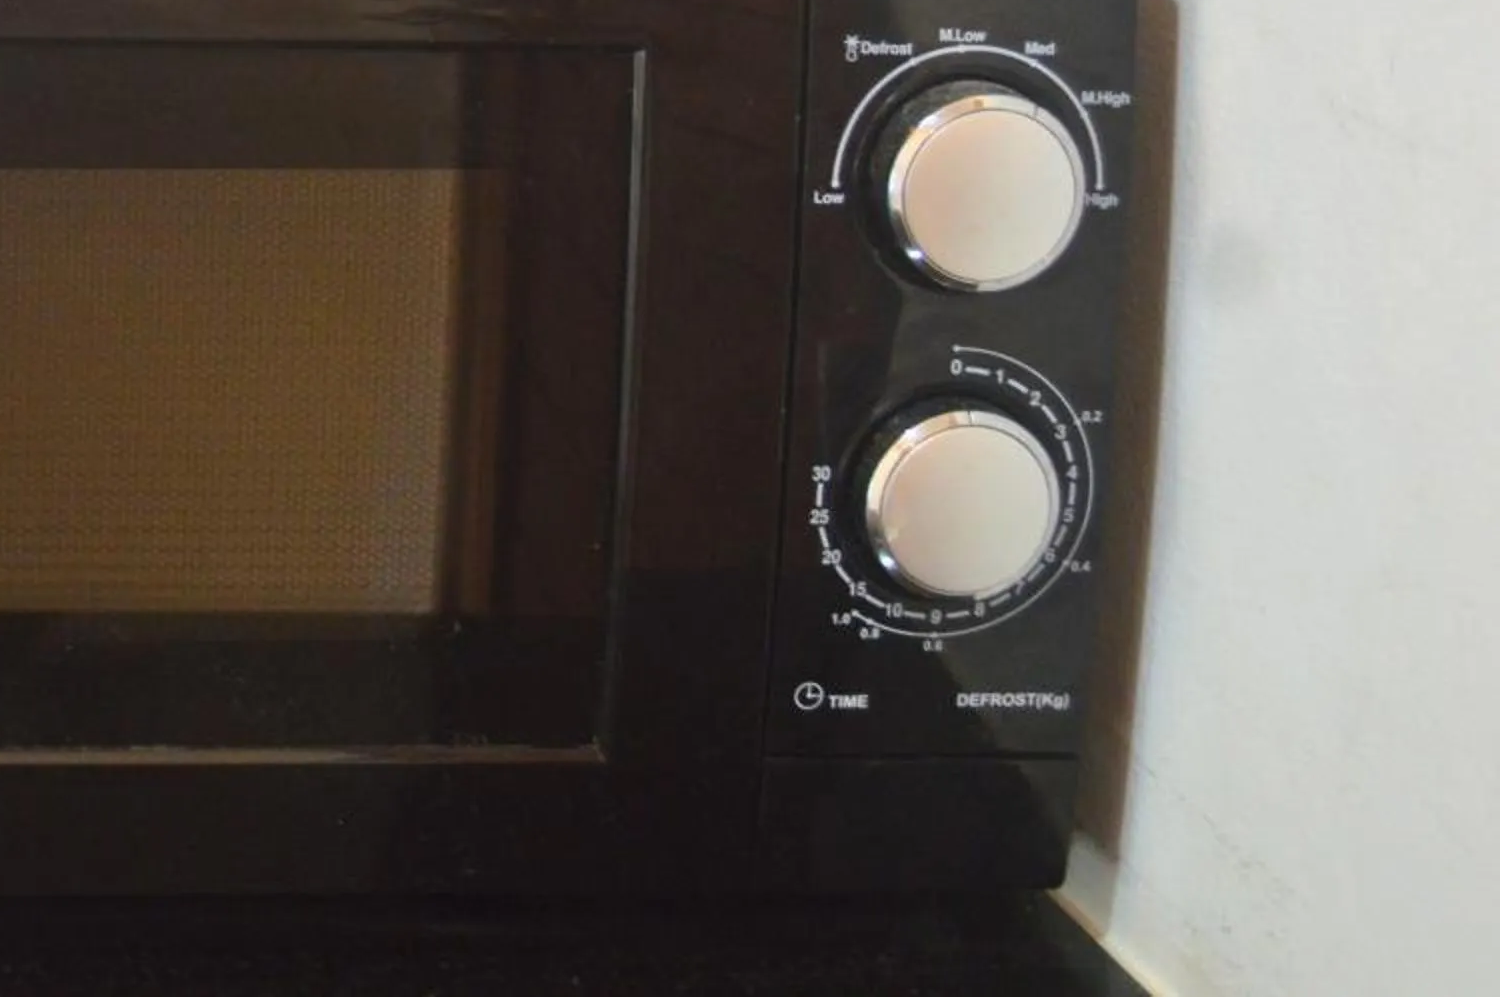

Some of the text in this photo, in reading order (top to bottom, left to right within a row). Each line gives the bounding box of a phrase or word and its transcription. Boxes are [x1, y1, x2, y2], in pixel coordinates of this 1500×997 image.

[938, 27, 987, 43] M.Low
[860, 39, 913, 56] Defrost
[1024, 41, 1056, 56] Med
[1081, 90, 1132, 109] M.High
[813, 190, 845, 205] Low
[1084, 193, 1120, 210] High
[951, 358, 963, 376] 0
[995, 368, 1005, 385] 1
[1029, 390, 1042, 406] 2
[1054, 423, 1067, 440] 3
[811, 465, 831, 482] 30
[1065, 464, 1078, 480] 4
[809, 508, 830, 525] 25
[1063, 507, 1075, 523] 5
[821, 549, 842, 565] 20
[1070, 559, 1091, 573] 0.4
[849, 581, 867, 596] 15
[884, 603, 904, 618] 10
[929, 609, 942, 625] 9
[828, 694, 869, 709] TIME
[955, 692, 1071, 710] DEFROST(Kg)
